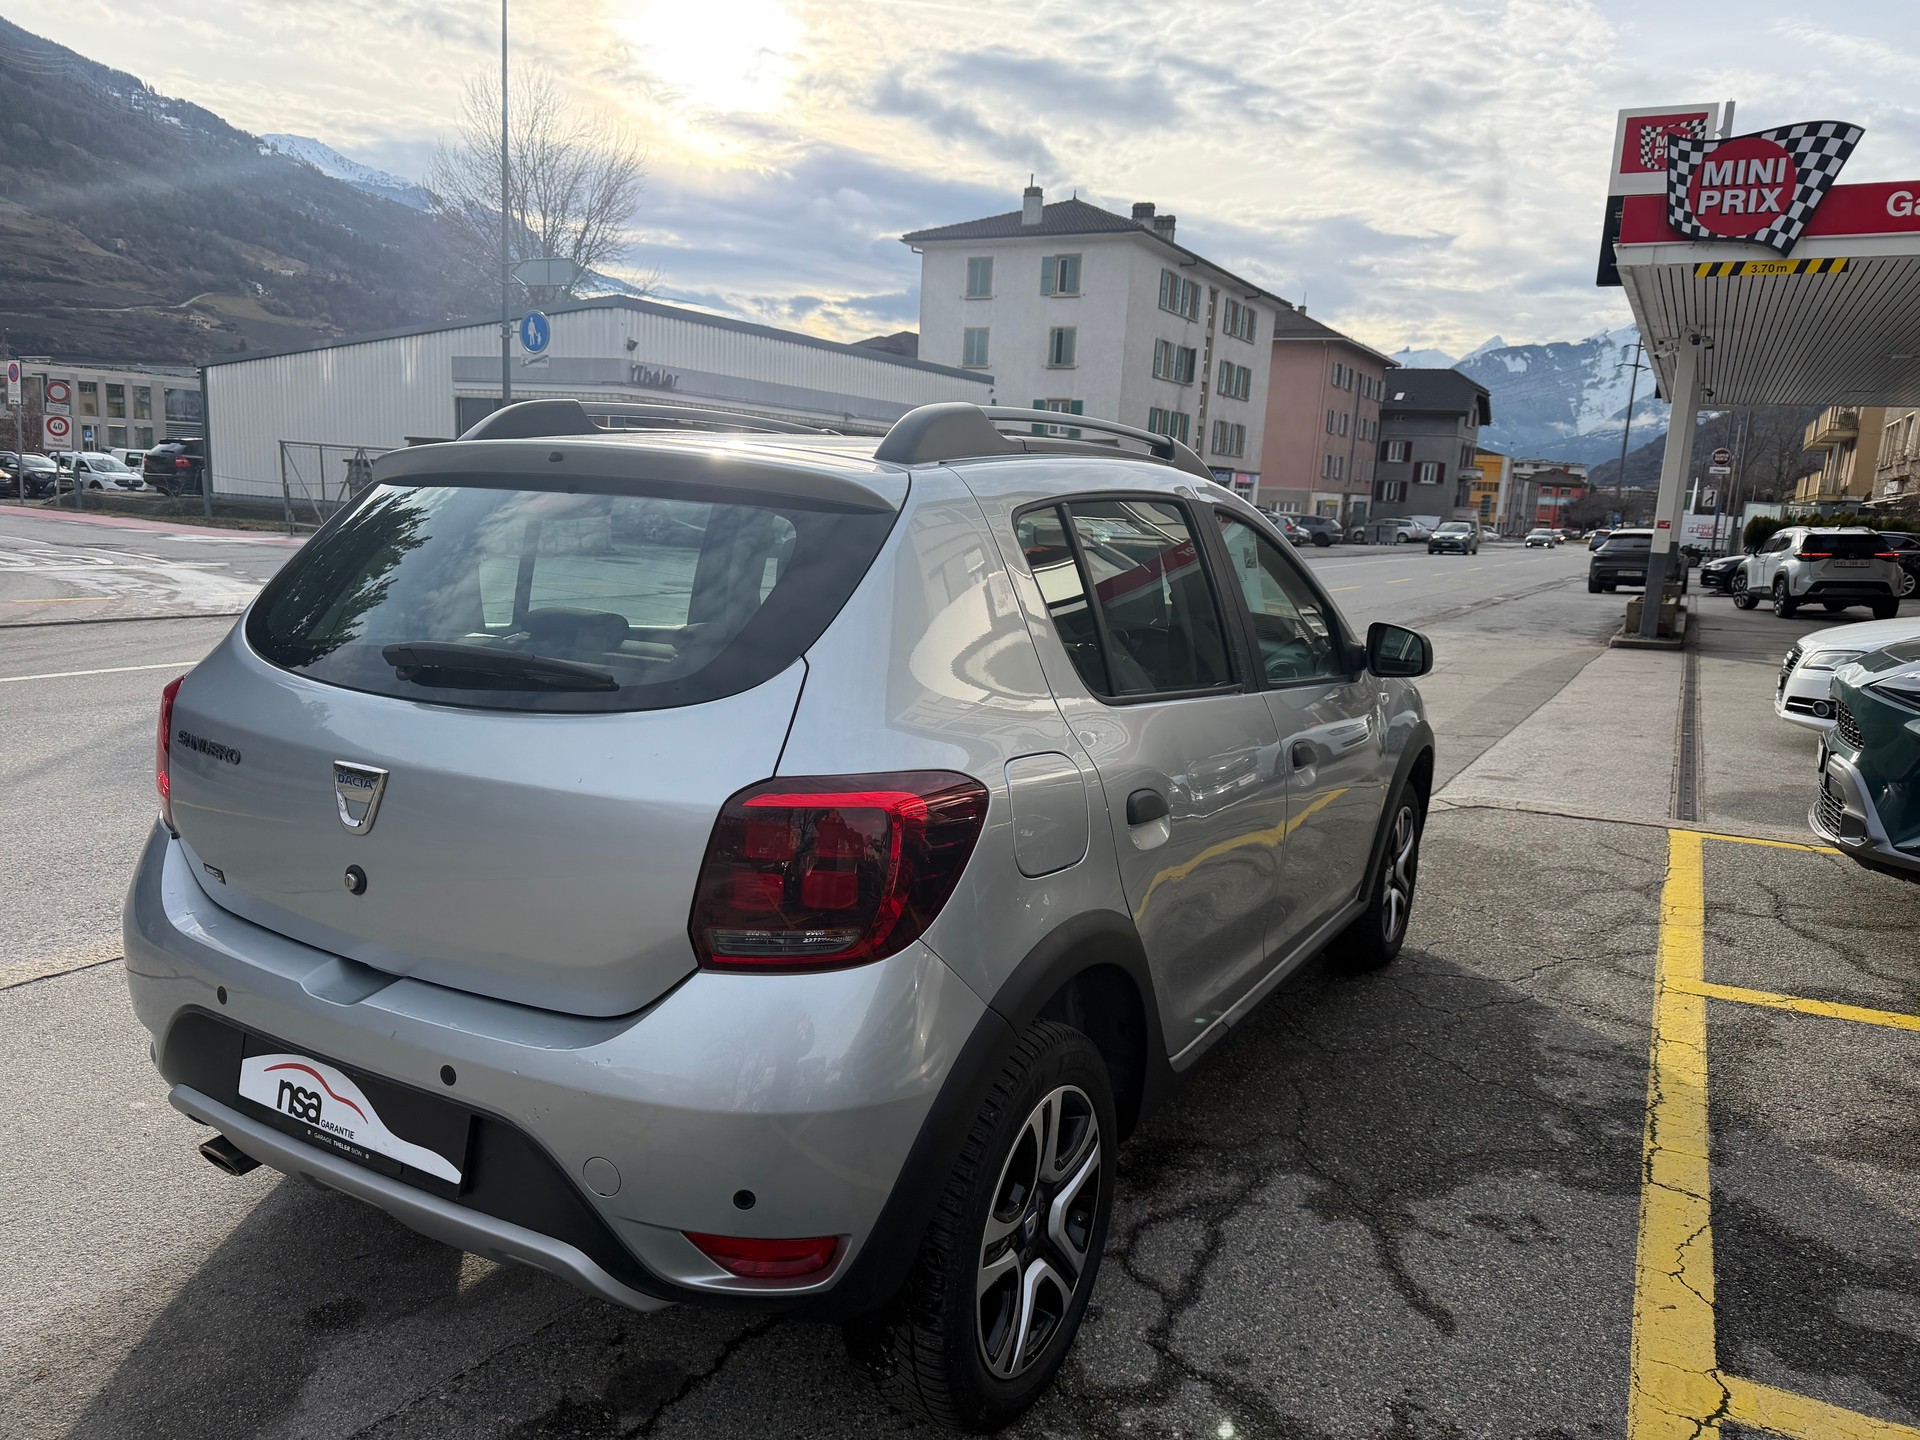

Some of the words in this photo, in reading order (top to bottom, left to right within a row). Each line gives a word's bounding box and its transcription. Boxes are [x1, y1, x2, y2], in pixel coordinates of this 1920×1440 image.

[1701, 157, 1787, 187] MINI
[1697, 187, 1784, 215] PRIX
[53, 422, 63, 431] 40
[178, 730, 241, 765] SANDERO
[337, 773, 373, 790] DACIA
[277, 1079, 322, 1126] nsa
[321, 1119, 355, 1140] GARANTIE
[314, 1132, 332, 1145] GARAGE
[333, 1140, 351, 1152] THELER
[351, 1147, 363, 1157] SION
